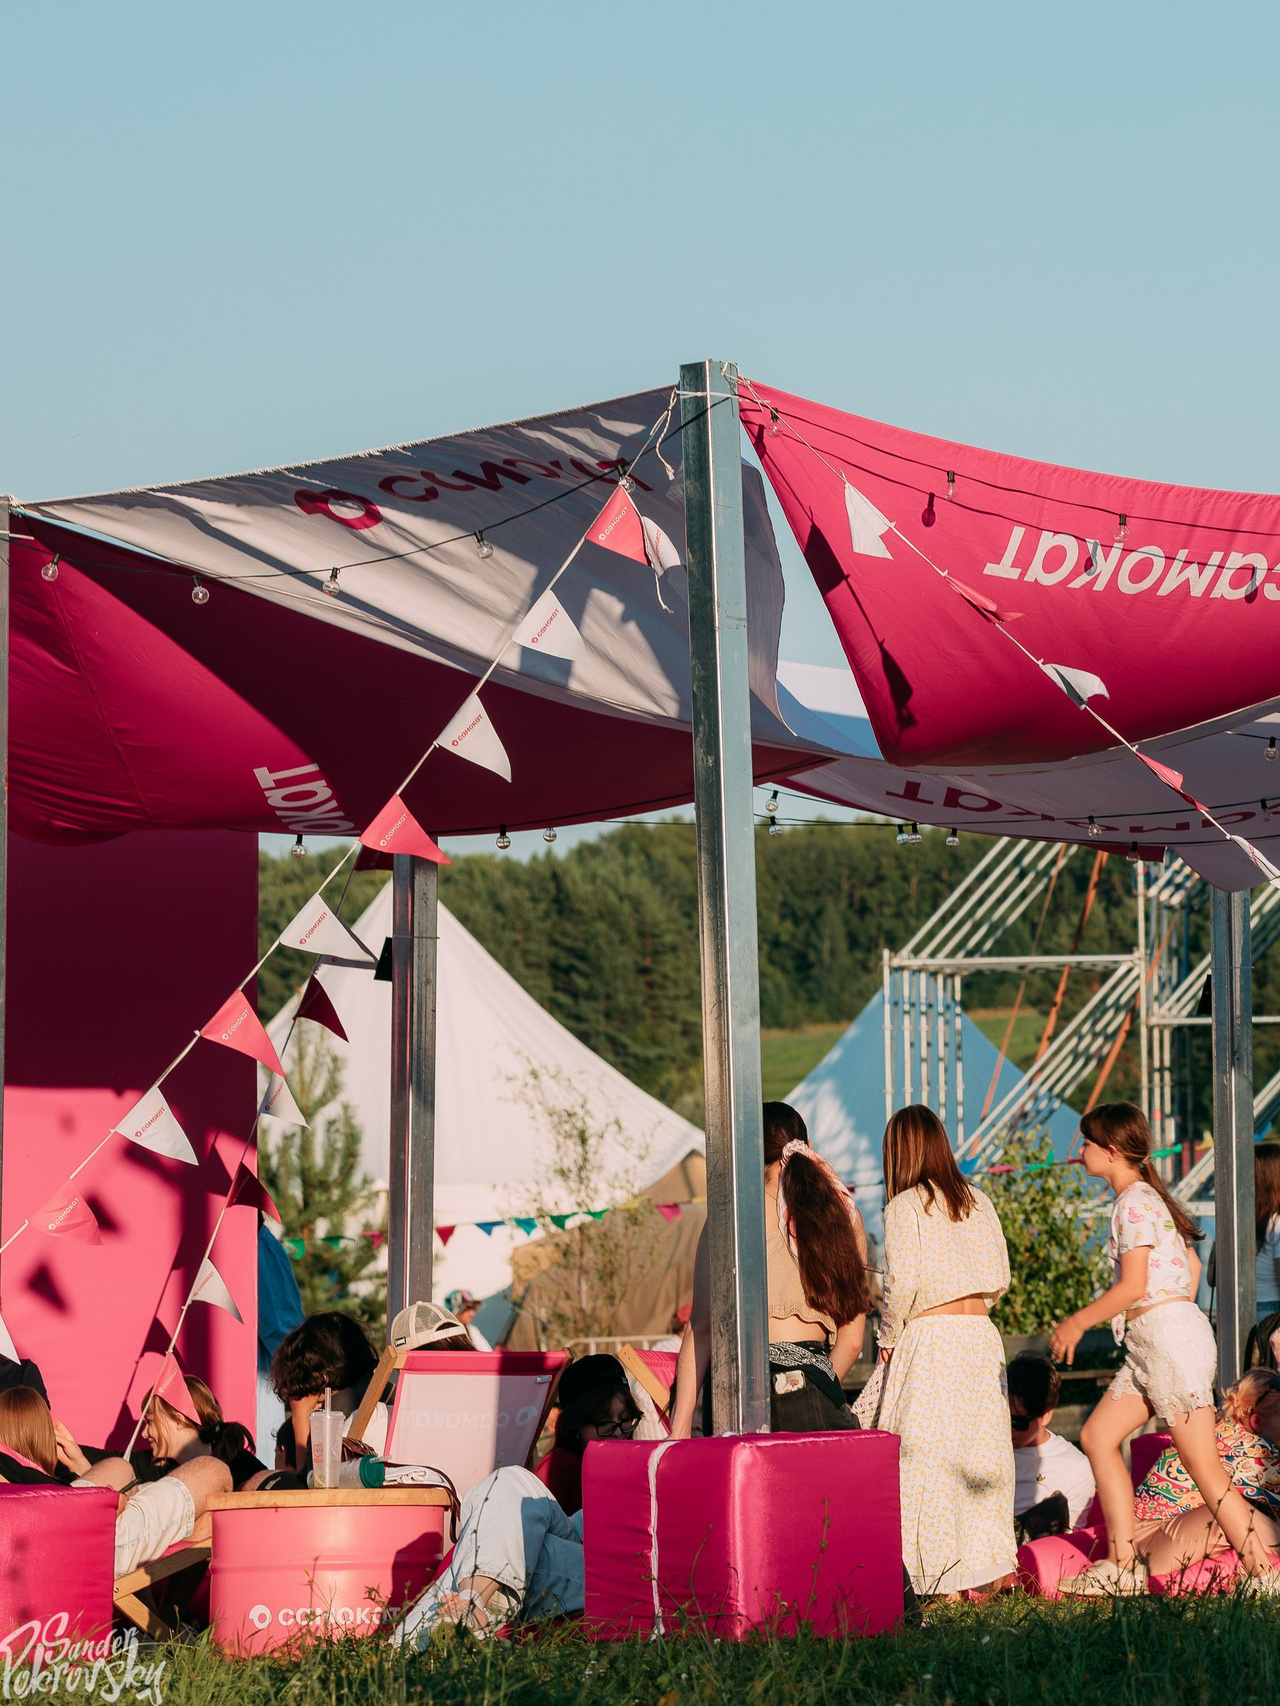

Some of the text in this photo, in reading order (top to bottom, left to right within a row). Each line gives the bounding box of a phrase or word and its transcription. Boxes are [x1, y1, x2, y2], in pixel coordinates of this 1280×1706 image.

[605, 506, 629, 534] самокат
[538, 608, 560, 636] самокат
[457, 714, 483, 741] самокат
[385, 813, 409, 840] самокат
[305, 911, 329, 939] самокат
[228, 1009, 250, 1034] самокат
[142, 1107, 166, 1132] самокат
[55, 1198, 80, 1225] самокат
